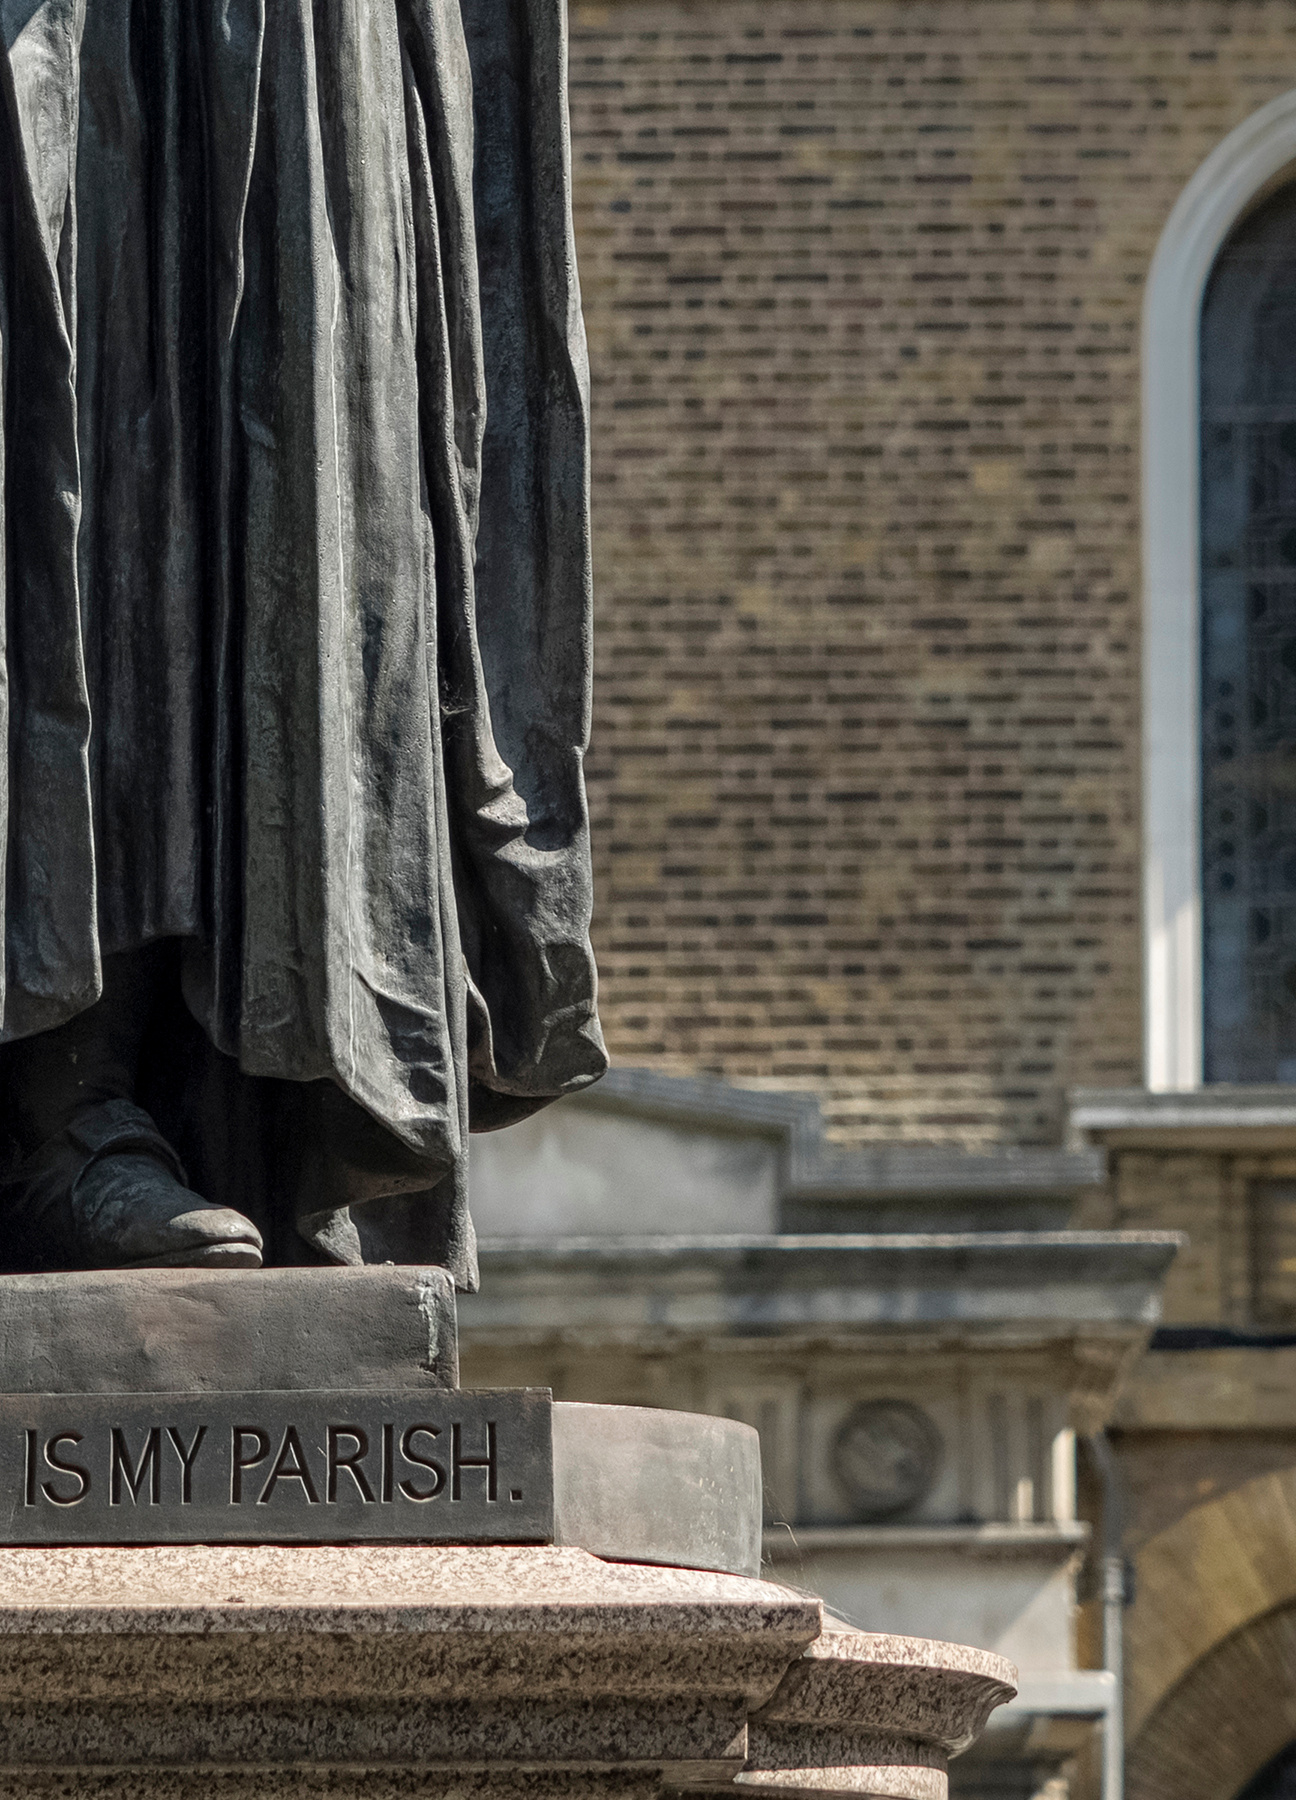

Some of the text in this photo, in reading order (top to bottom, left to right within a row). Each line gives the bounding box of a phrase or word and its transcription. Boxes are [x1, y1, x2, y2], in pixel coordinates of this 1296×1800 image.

[25, 1430, 91, 1507] IS
[108, 1425, 208, 1505] MY
[230, 1421, 525, 1505] PARISH.
